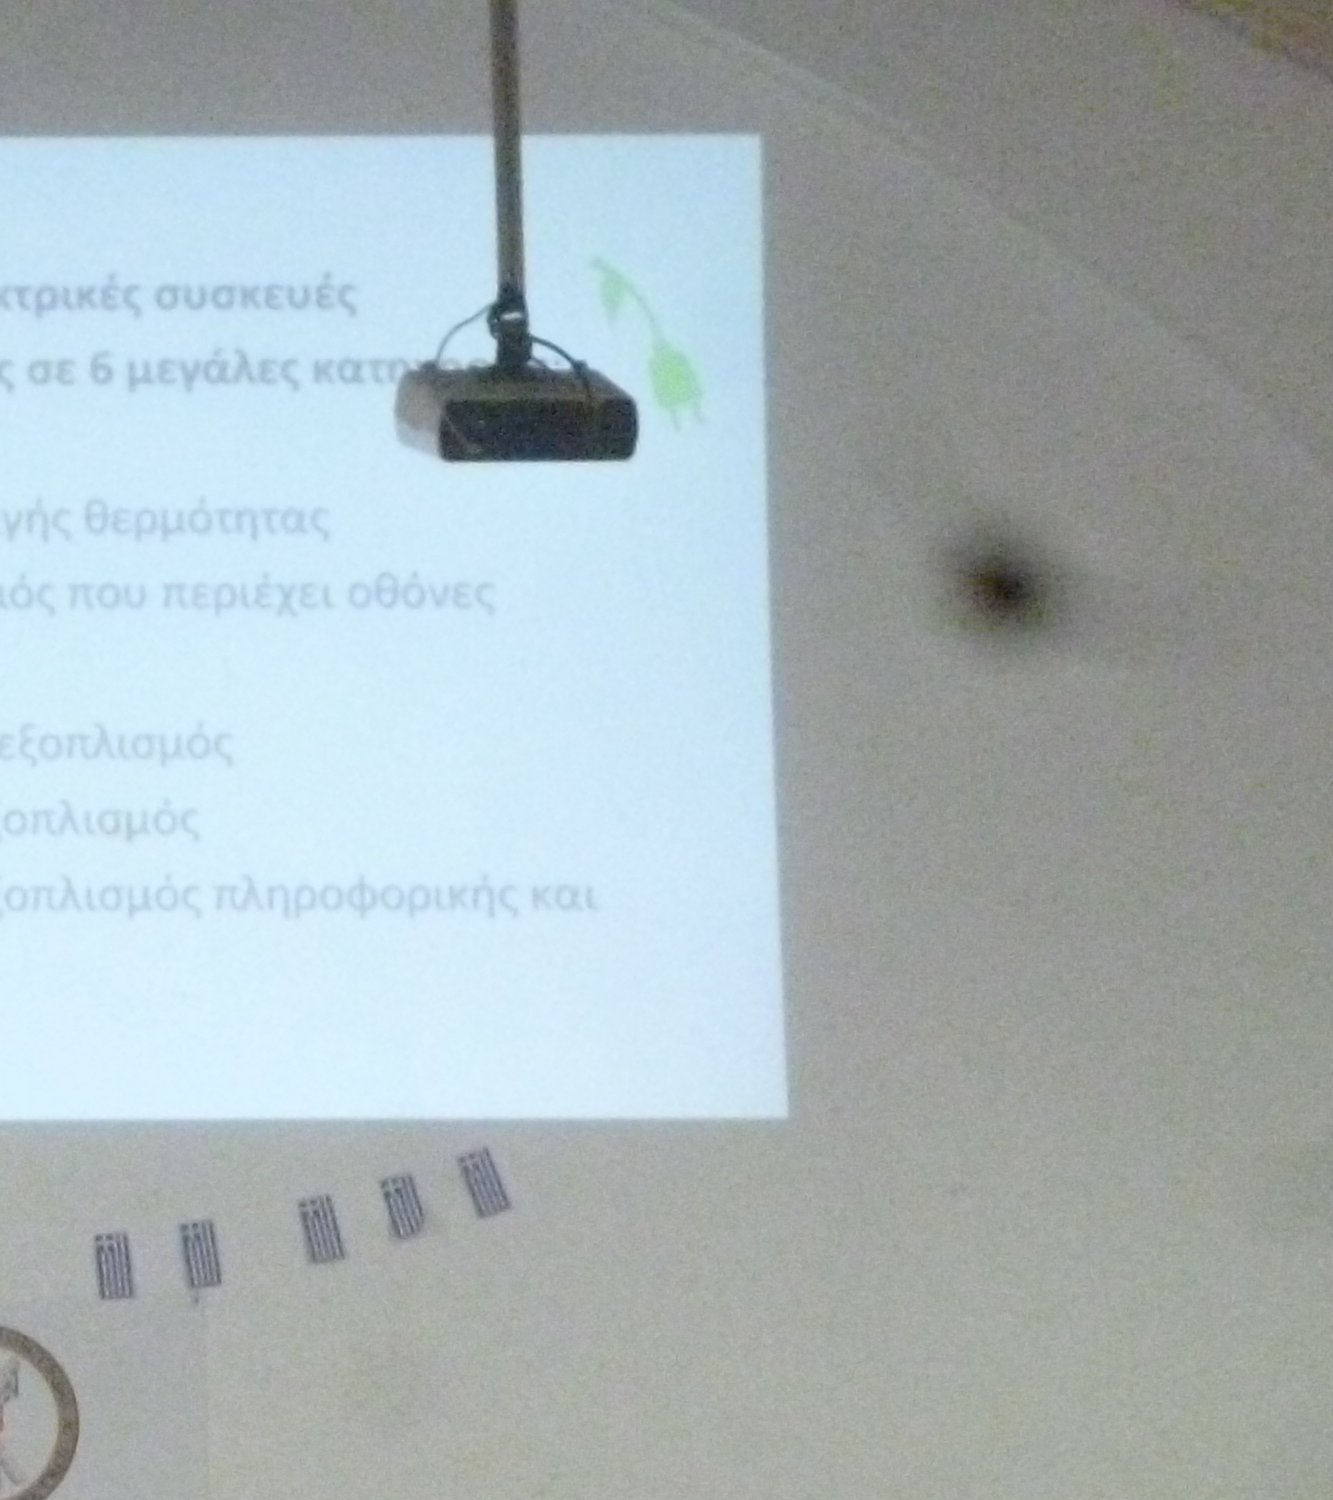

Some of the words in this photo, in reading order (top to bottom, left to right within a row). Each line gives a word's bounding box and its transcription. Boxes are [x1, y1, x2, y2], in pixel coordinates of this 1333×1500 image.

[154, 272, 357, 316] συσκευές
[28, 359, 74, 385] σε
[90, 352, 113, 384] 6
[128, 349, 299, 391] μεγάλες
[84, 498, 330, 542] θερμότητας
[68, 583, 147, 610] που
[163, 573, 333, 617] περιέχει
[348, 572, 495, 615] οθόνες
[215, 874, 519, 919] πληροφορικής
[532, 884, 598, 911] και
